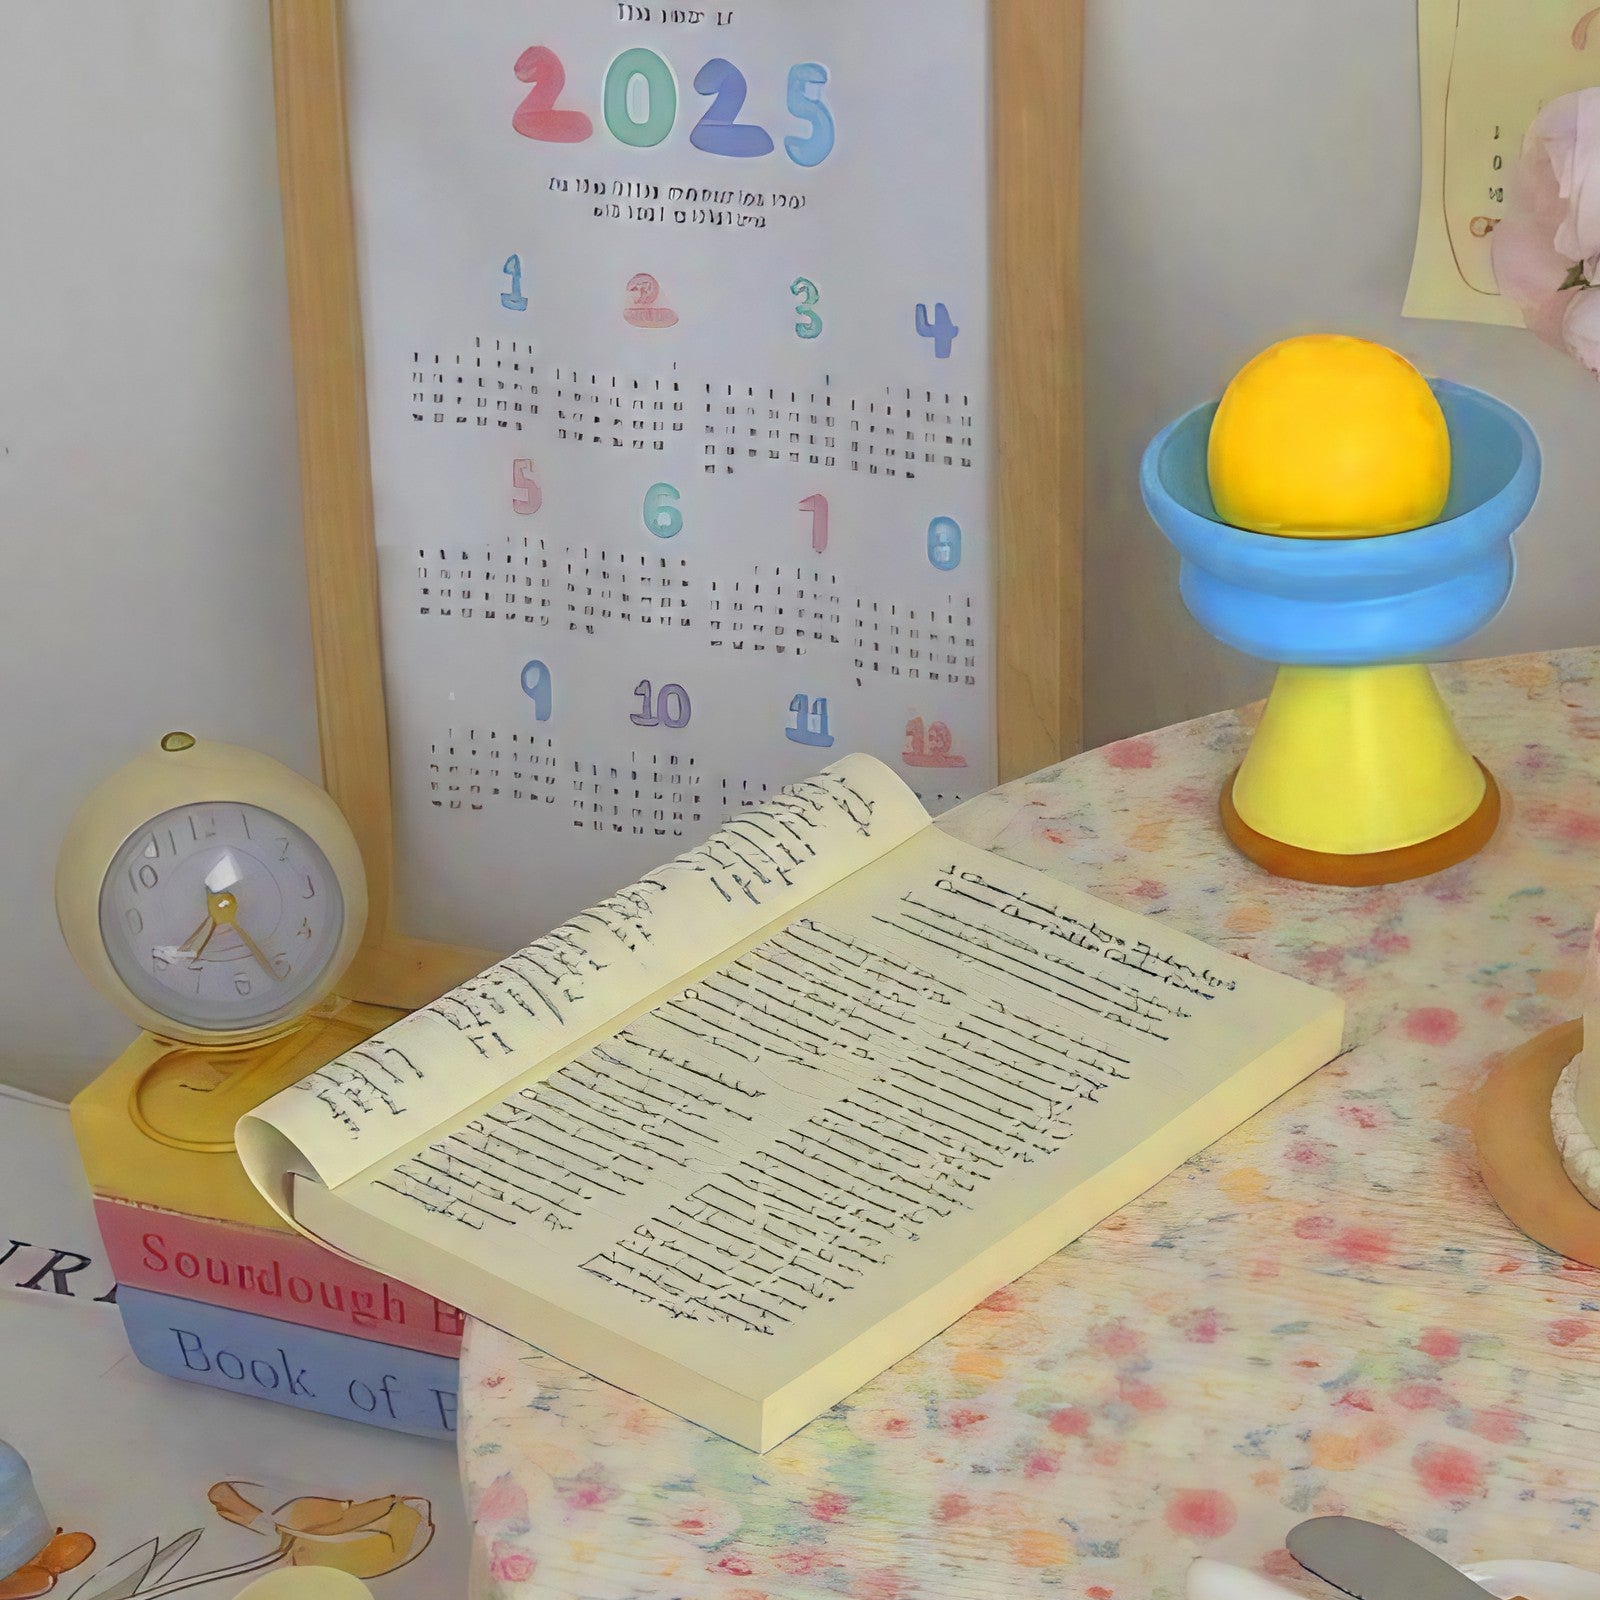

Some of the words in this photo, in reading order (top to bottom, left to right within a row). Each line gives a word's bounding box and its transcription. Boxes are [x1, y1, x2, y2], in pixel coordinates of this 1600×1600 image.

[512, 45, 837, 168] 2025
[501, 254, 528, 312] 1
[624, 273, 680, 328] 2
[790, 276, 823, 340] 3
[915, 303, 960, 359] 4
[512, 459, 543, 516] 5
[642, 482, 684, 538] 6
[520, 659, 552, 722] 9
[629, 679, 693, 729] 10
[785, 693, 835, 748] 11
[142, 1233, 405, 1330] Sourdough
[168, 1327, 316, 1398] Book
[349, 1374, 401, 1419] of
